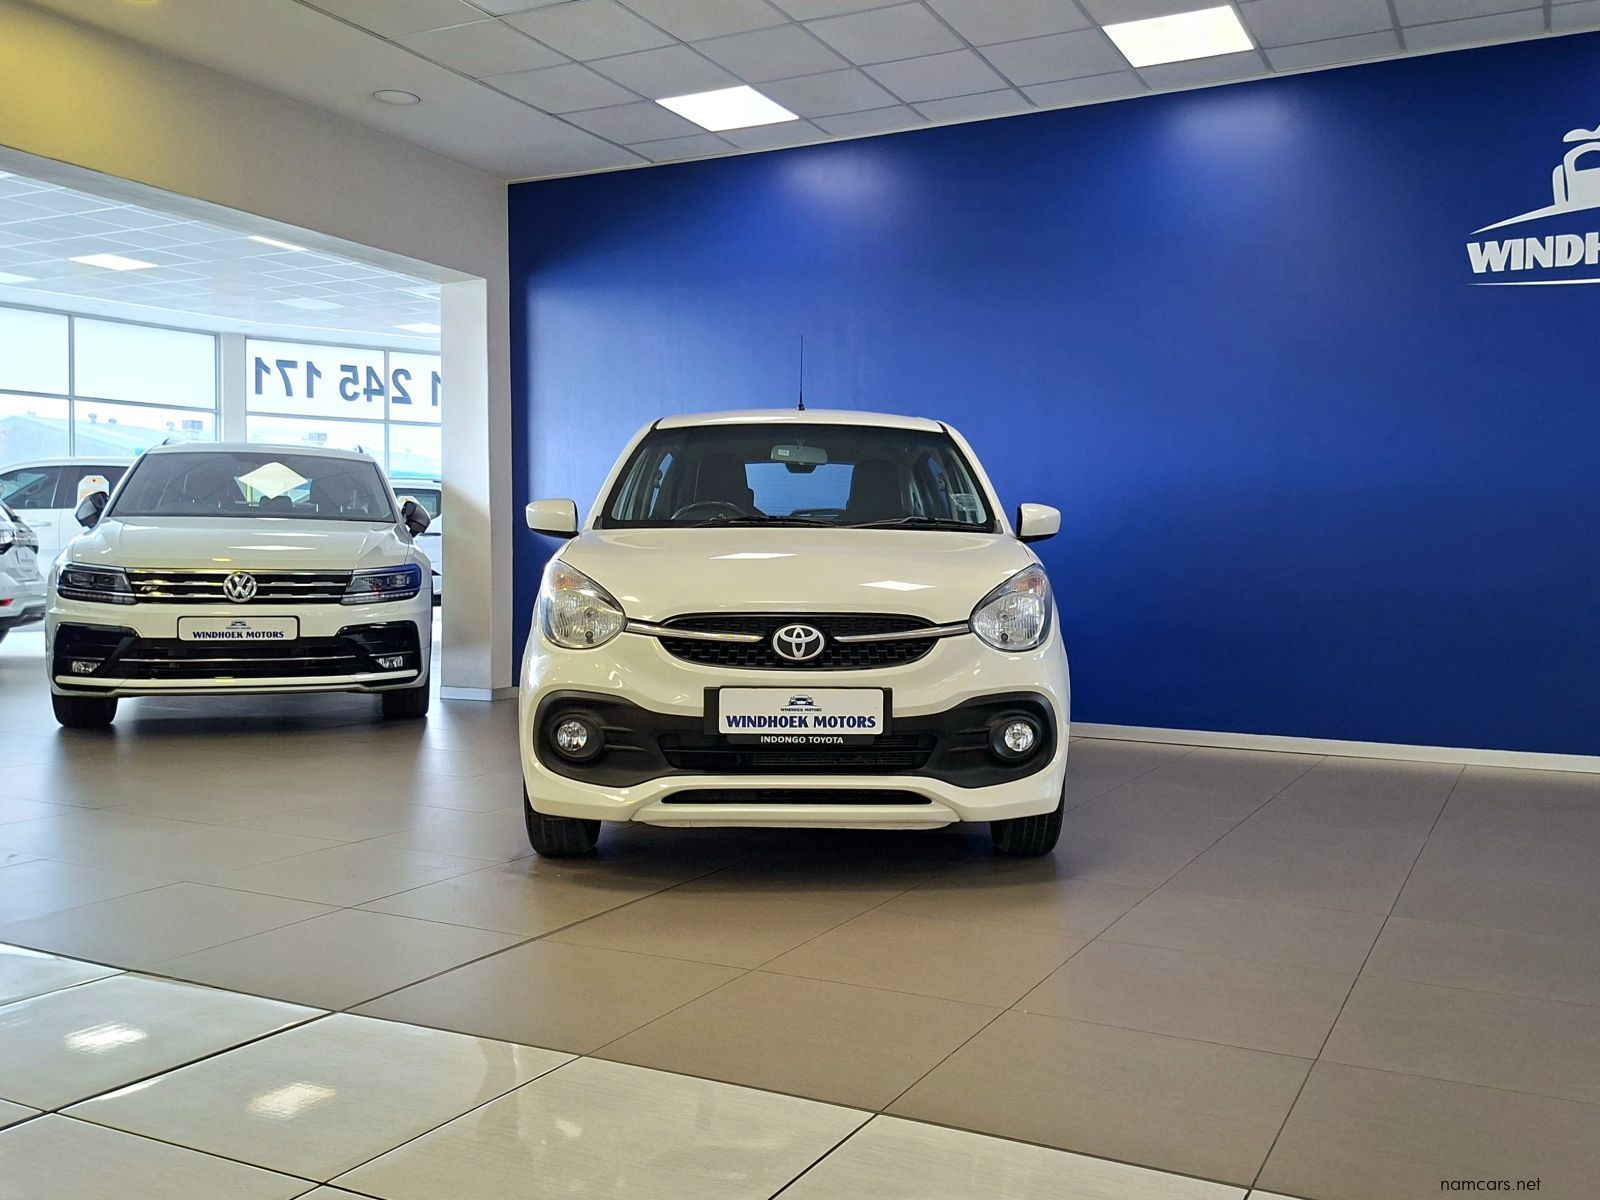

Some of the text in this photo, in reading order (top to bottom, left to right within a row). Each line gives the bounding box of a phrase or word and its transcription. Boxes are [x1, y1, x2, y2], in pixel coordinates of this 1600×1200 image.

[192, 631, 243, 639] WINDHOEK
[726, 715, 876, 728] WINDHOEK MOTORS
[760, 736, 844, 744] INDONGO TOYOTA
